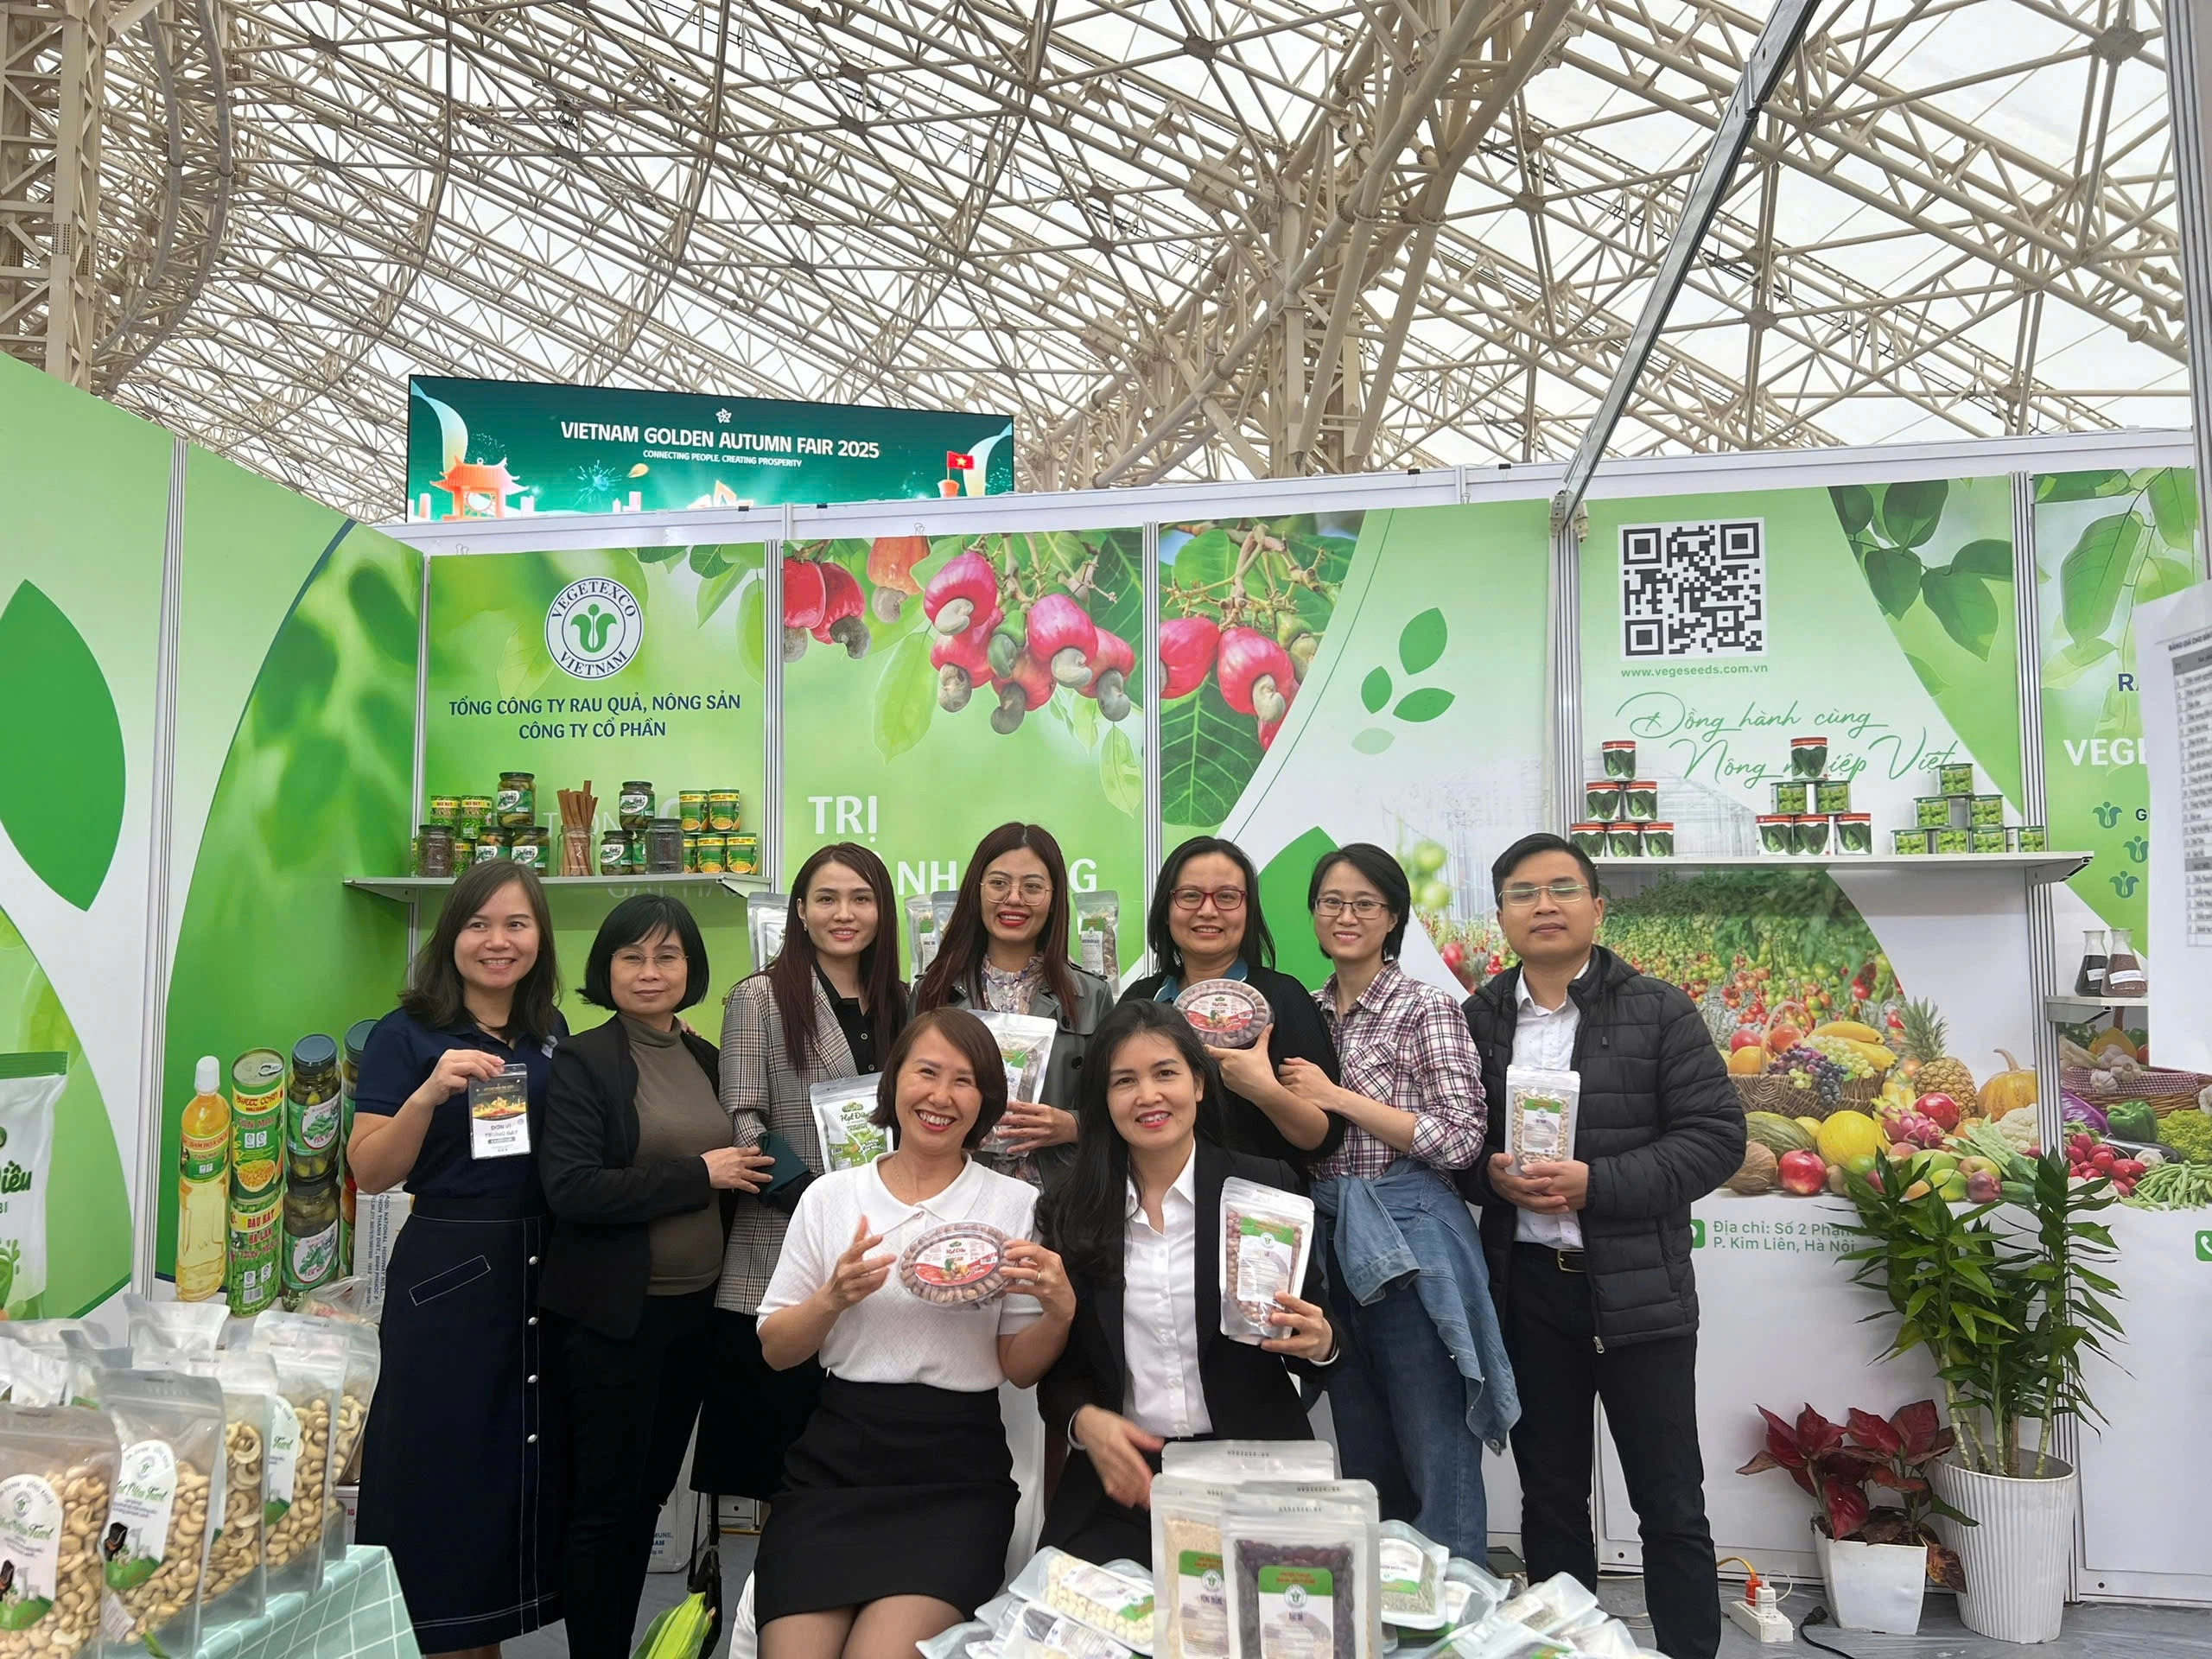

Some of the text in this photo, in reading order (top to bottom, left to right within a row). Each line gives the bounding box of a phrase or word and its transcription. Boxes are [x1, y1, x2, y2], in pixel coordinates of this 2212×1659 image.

[561, 421, 880, 459] VIETNAM GOLDEN AUTUMN FAIR 2025
[643, 449, 690, 461] CONNECTING
[721, 455, 757, 465] CREATING
[758, 457, 802, 467] PROSPERITY
[551, 581, 637, 618] VEGETEXCO
[560, 651, 628, 676] VIETNAM
[1621, 664, 1768, 677] www.vegeseeds.com.vn
[448, 690, 741, 715] TỔNG CÔNG TY RAU QUẢ, NÔNG SẢN
[519, 717, 665, 740] CÔNG TY CỔ PHẦN
[1739, 701, 1800, 728] hành
[1815, 709, 1889, 739] cùng
[1669, 739, 1783, 789] Nông
[808, 795, 878, 843] TRỊ
[0, 1160, 33, 1194] iều
[1713, 1220, 1738, 1236] Địa
[1775, 1221, 1794, 1235] Số
[1798, 1224, 1807, 1236] 2
[1713, 1236, 1726, 1249] P.
[1730, 1236, 1759, 1249] Kim
[1764, 1237, 1800, 1253] Liên,
[1804, 1238, 1825, 1252] Hà
